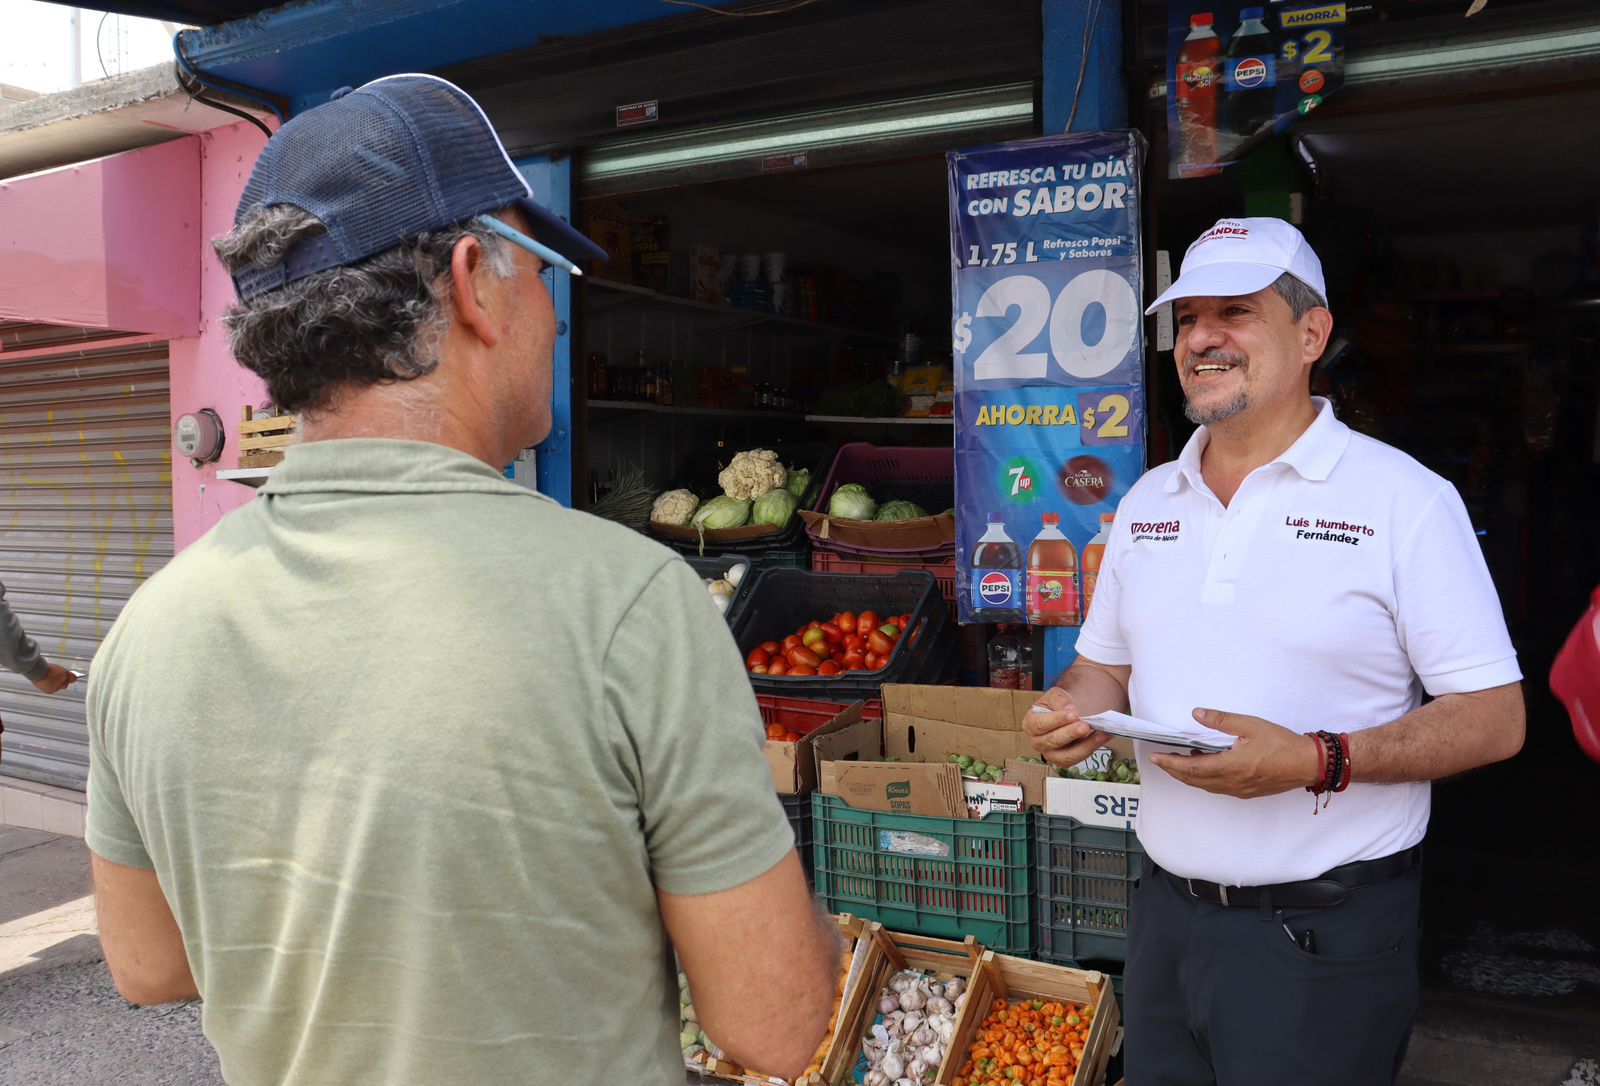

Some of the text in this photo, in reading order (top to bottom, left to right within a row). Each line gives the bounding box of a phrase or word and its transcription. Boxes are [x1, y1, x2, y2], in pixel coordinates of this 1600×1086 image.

[1286, 9, 1340, 24] AHORRA
[1236, 68, 1265, 77] PEPSI
[967, 155, 1127, 190] REFRESCA TU DÍA
[967, 182, 1127, 217] CON SABOR
[1043, 238, 1089, 250] Refresco
[967, 242, 1039, 267] 1,75 L
[1059, 248, 1113, 261] y Sabores
[975, 404, 1077, 427] AHORRA
[1064, 476, 1105, 489] CASERA
[1131, 520, 1181, 535] morena
[1285, 516, 1375, 537] Luis Humberto
[1296, 529, 1360, 546] Fernández
[982, 584, 1010, 593] PEPSI
